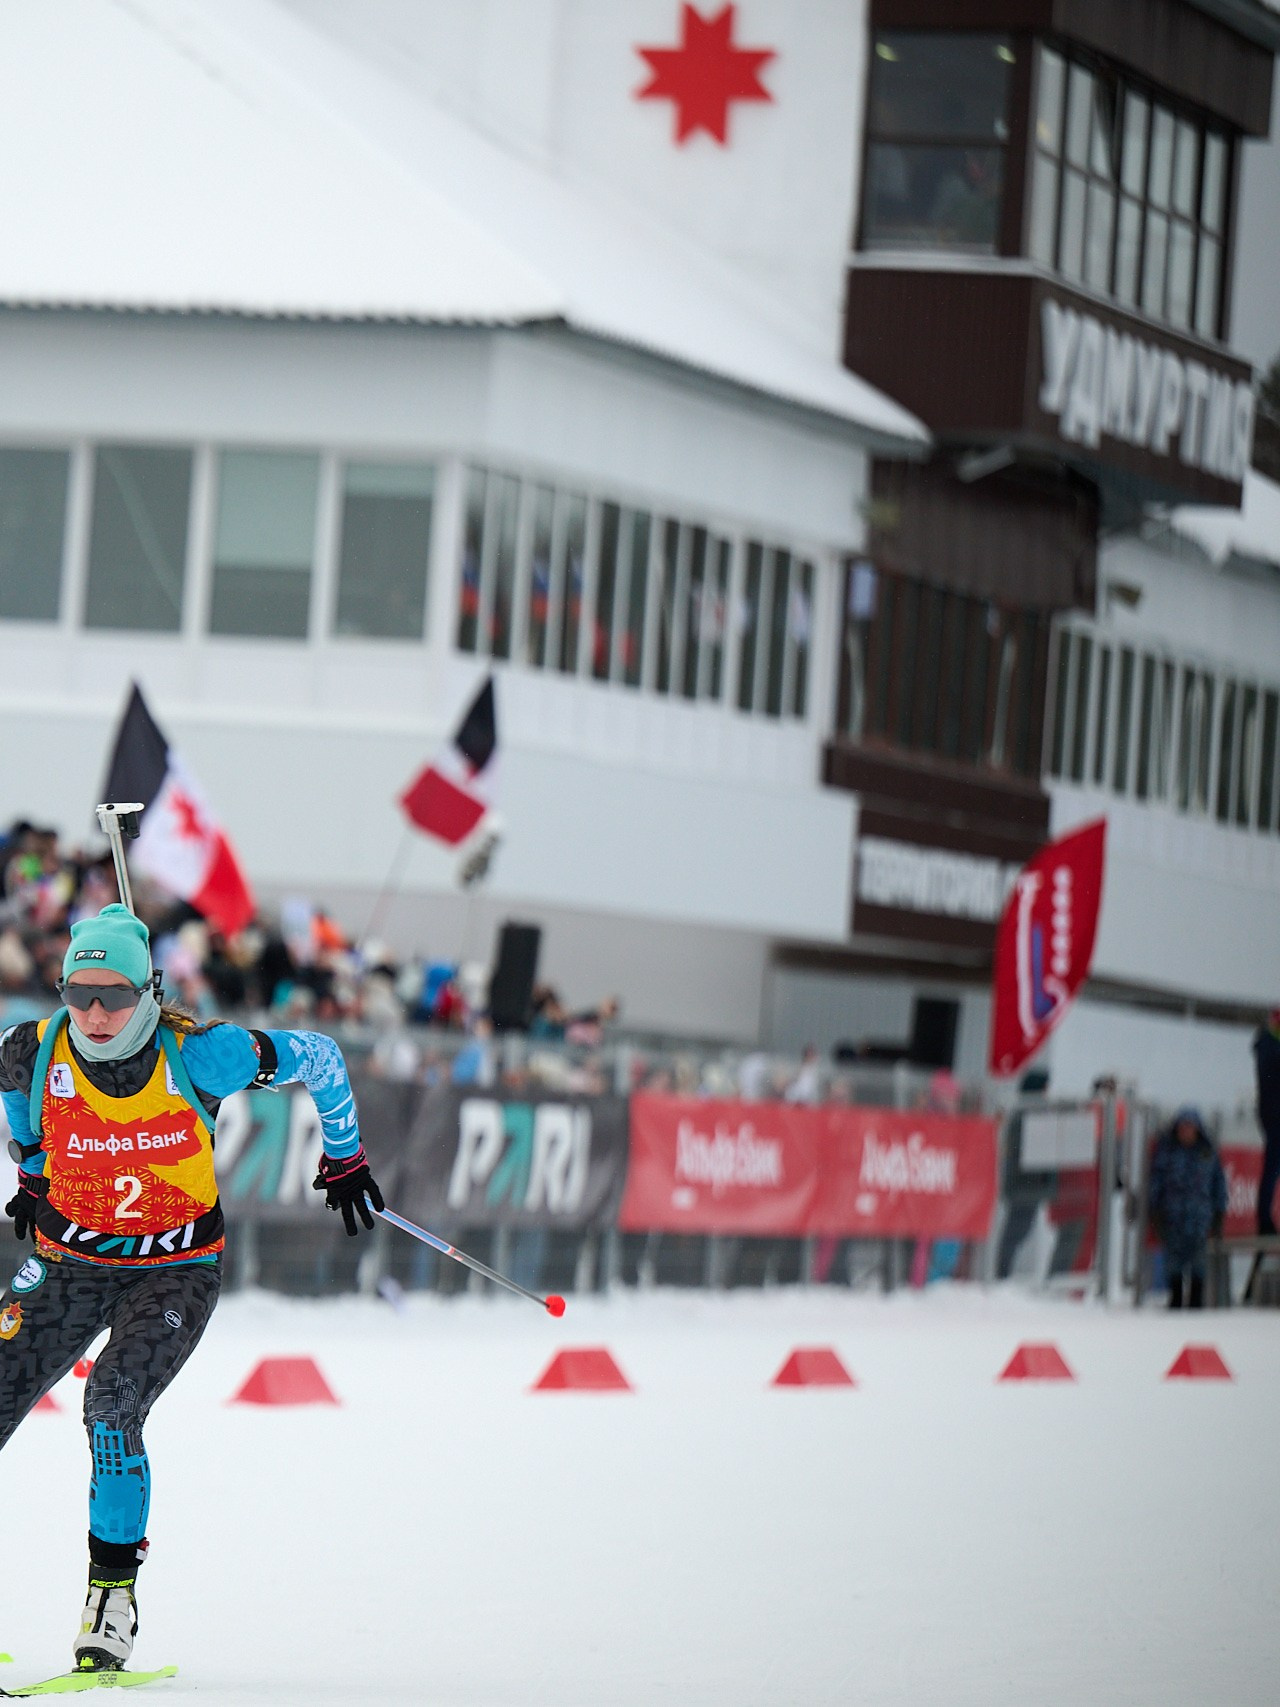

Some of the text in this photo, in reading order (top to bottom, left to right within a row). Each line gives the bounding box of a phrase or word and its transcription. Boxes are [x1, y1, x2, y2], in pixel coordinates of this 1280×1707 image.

[75, 951, 106, 960] PARI
[67, 1129, 189, 1154] Альфа Банк
[214, 1088, 324, 1202] PAR
[448, 1100, 593, 1213] PARI
[114, 1176, 143, 1219] 2
[90, 1579, 134, 1588] FISCHER
